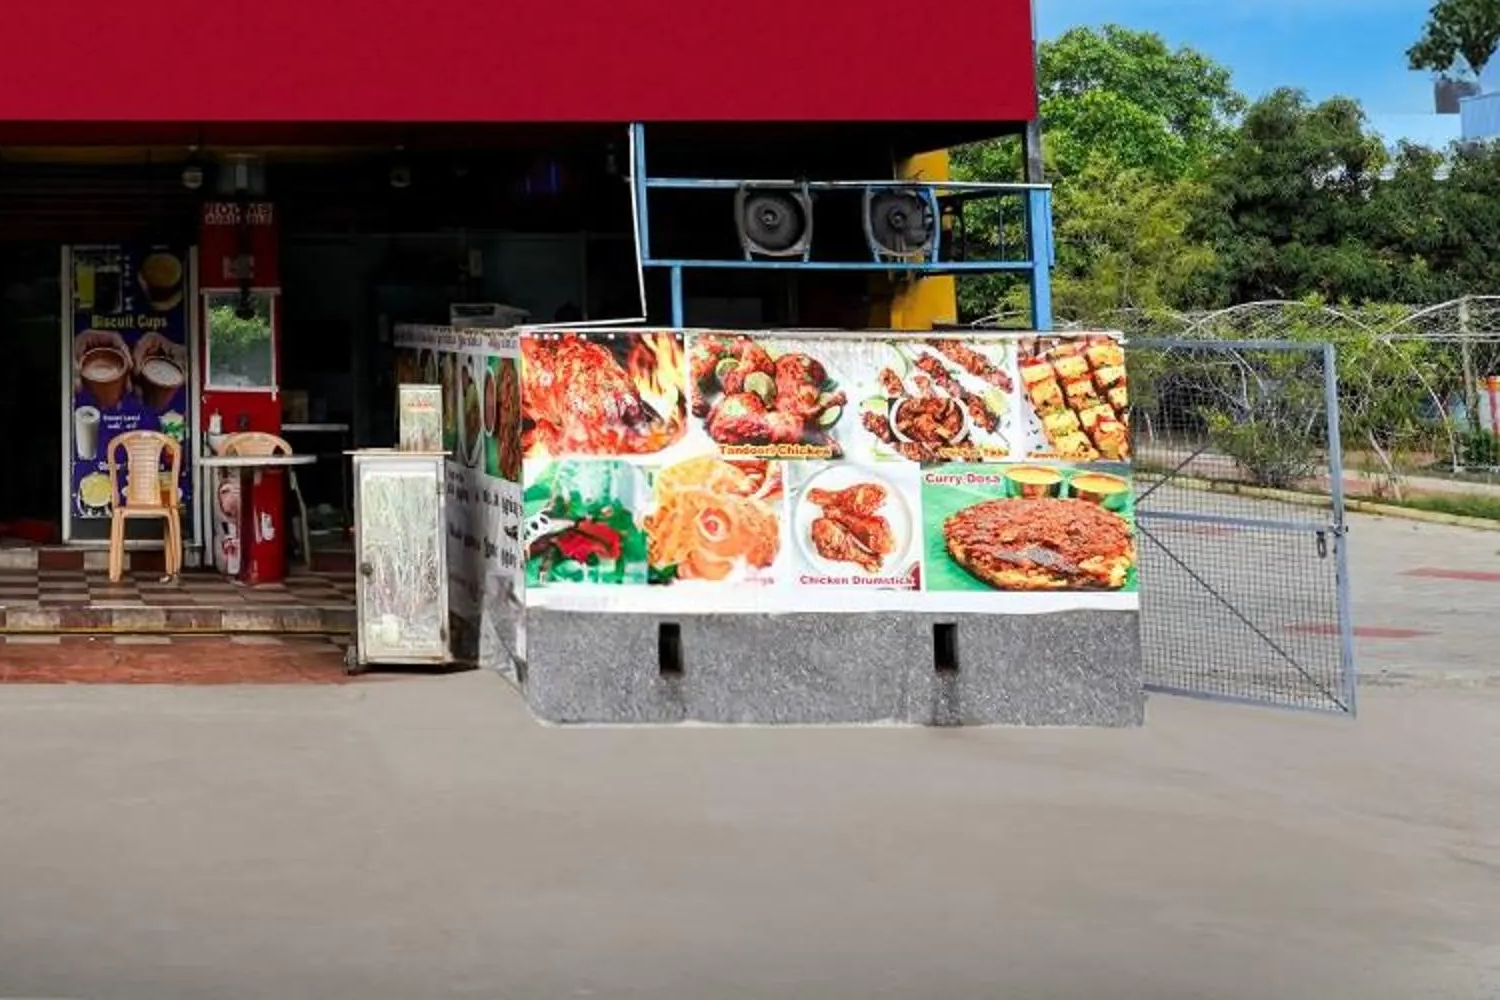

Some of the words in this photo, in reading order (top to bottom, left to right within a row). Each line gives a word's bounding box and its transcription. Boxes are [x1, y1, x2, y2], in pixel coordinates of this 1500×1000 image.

[91, 314, 133, 328] Biscuit
[137, 314, 168, 330] Cups
[719, 443, 776, 456] Tandoori
[778, 443, 832, 456] Chicken
[925, 472, 962, 485] Curry
[966, 472, 1001, 484] Dosa
[799, 574, 849, 585] Chicken
